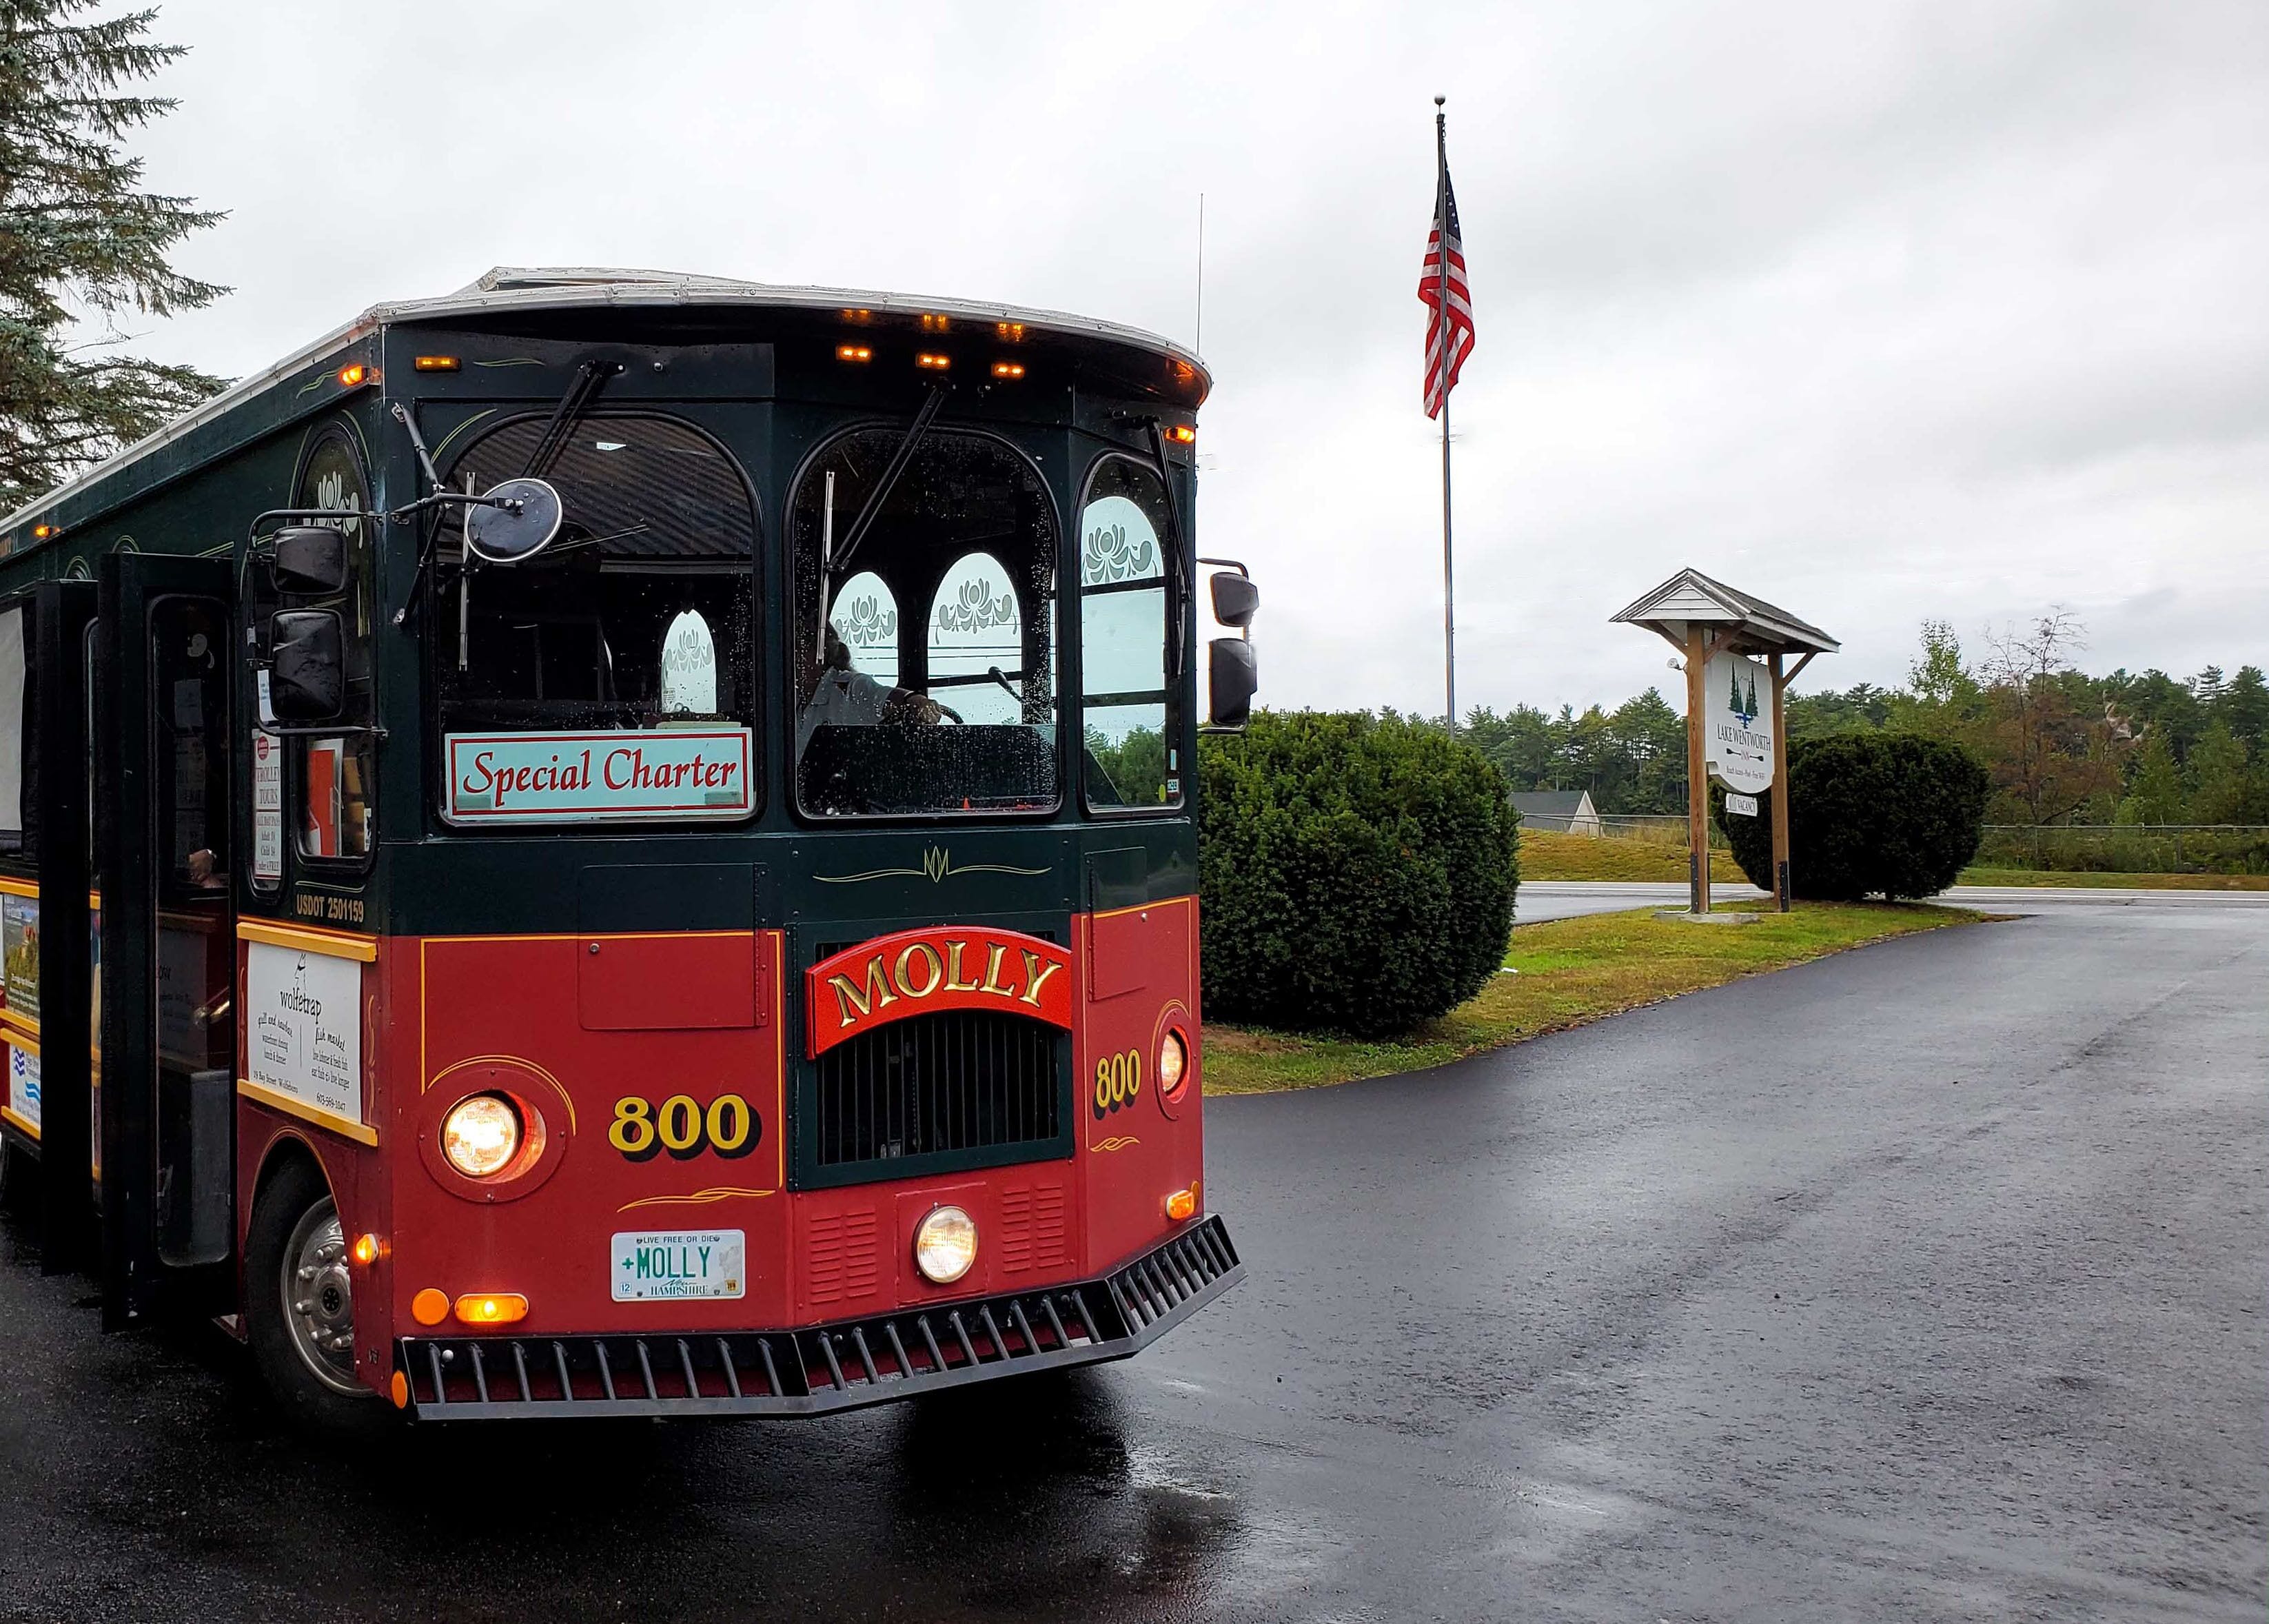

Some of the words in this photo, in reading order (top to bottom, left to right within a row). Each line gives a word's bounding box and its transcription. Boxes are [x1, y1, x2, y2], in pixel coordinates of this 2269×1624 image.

[1717, 724, 1732, 742] LAKE
[1733, 728, 1771, 751] WENTWORTH
[463, 749, 591, 807] Special
[602, 748, 737, 790] Charter
[259, 789, 277, 804] TOURS
[1737, 799, 1756, 813] VACANCY
[296, 894, 325, 917] USDOT
[327, 897, 364, 923] 2501159
[827, 940, 1062, 1028] MOLLY
[280, 987, 322, 1024] wolfetrap
[1095, 1048, 1141, 1110] 800
[608, 1093, 753, 1155] 800
[622, 1283, 631, 1292] 12
[650, 1284, 708, 1296] HAMPSHIRE
